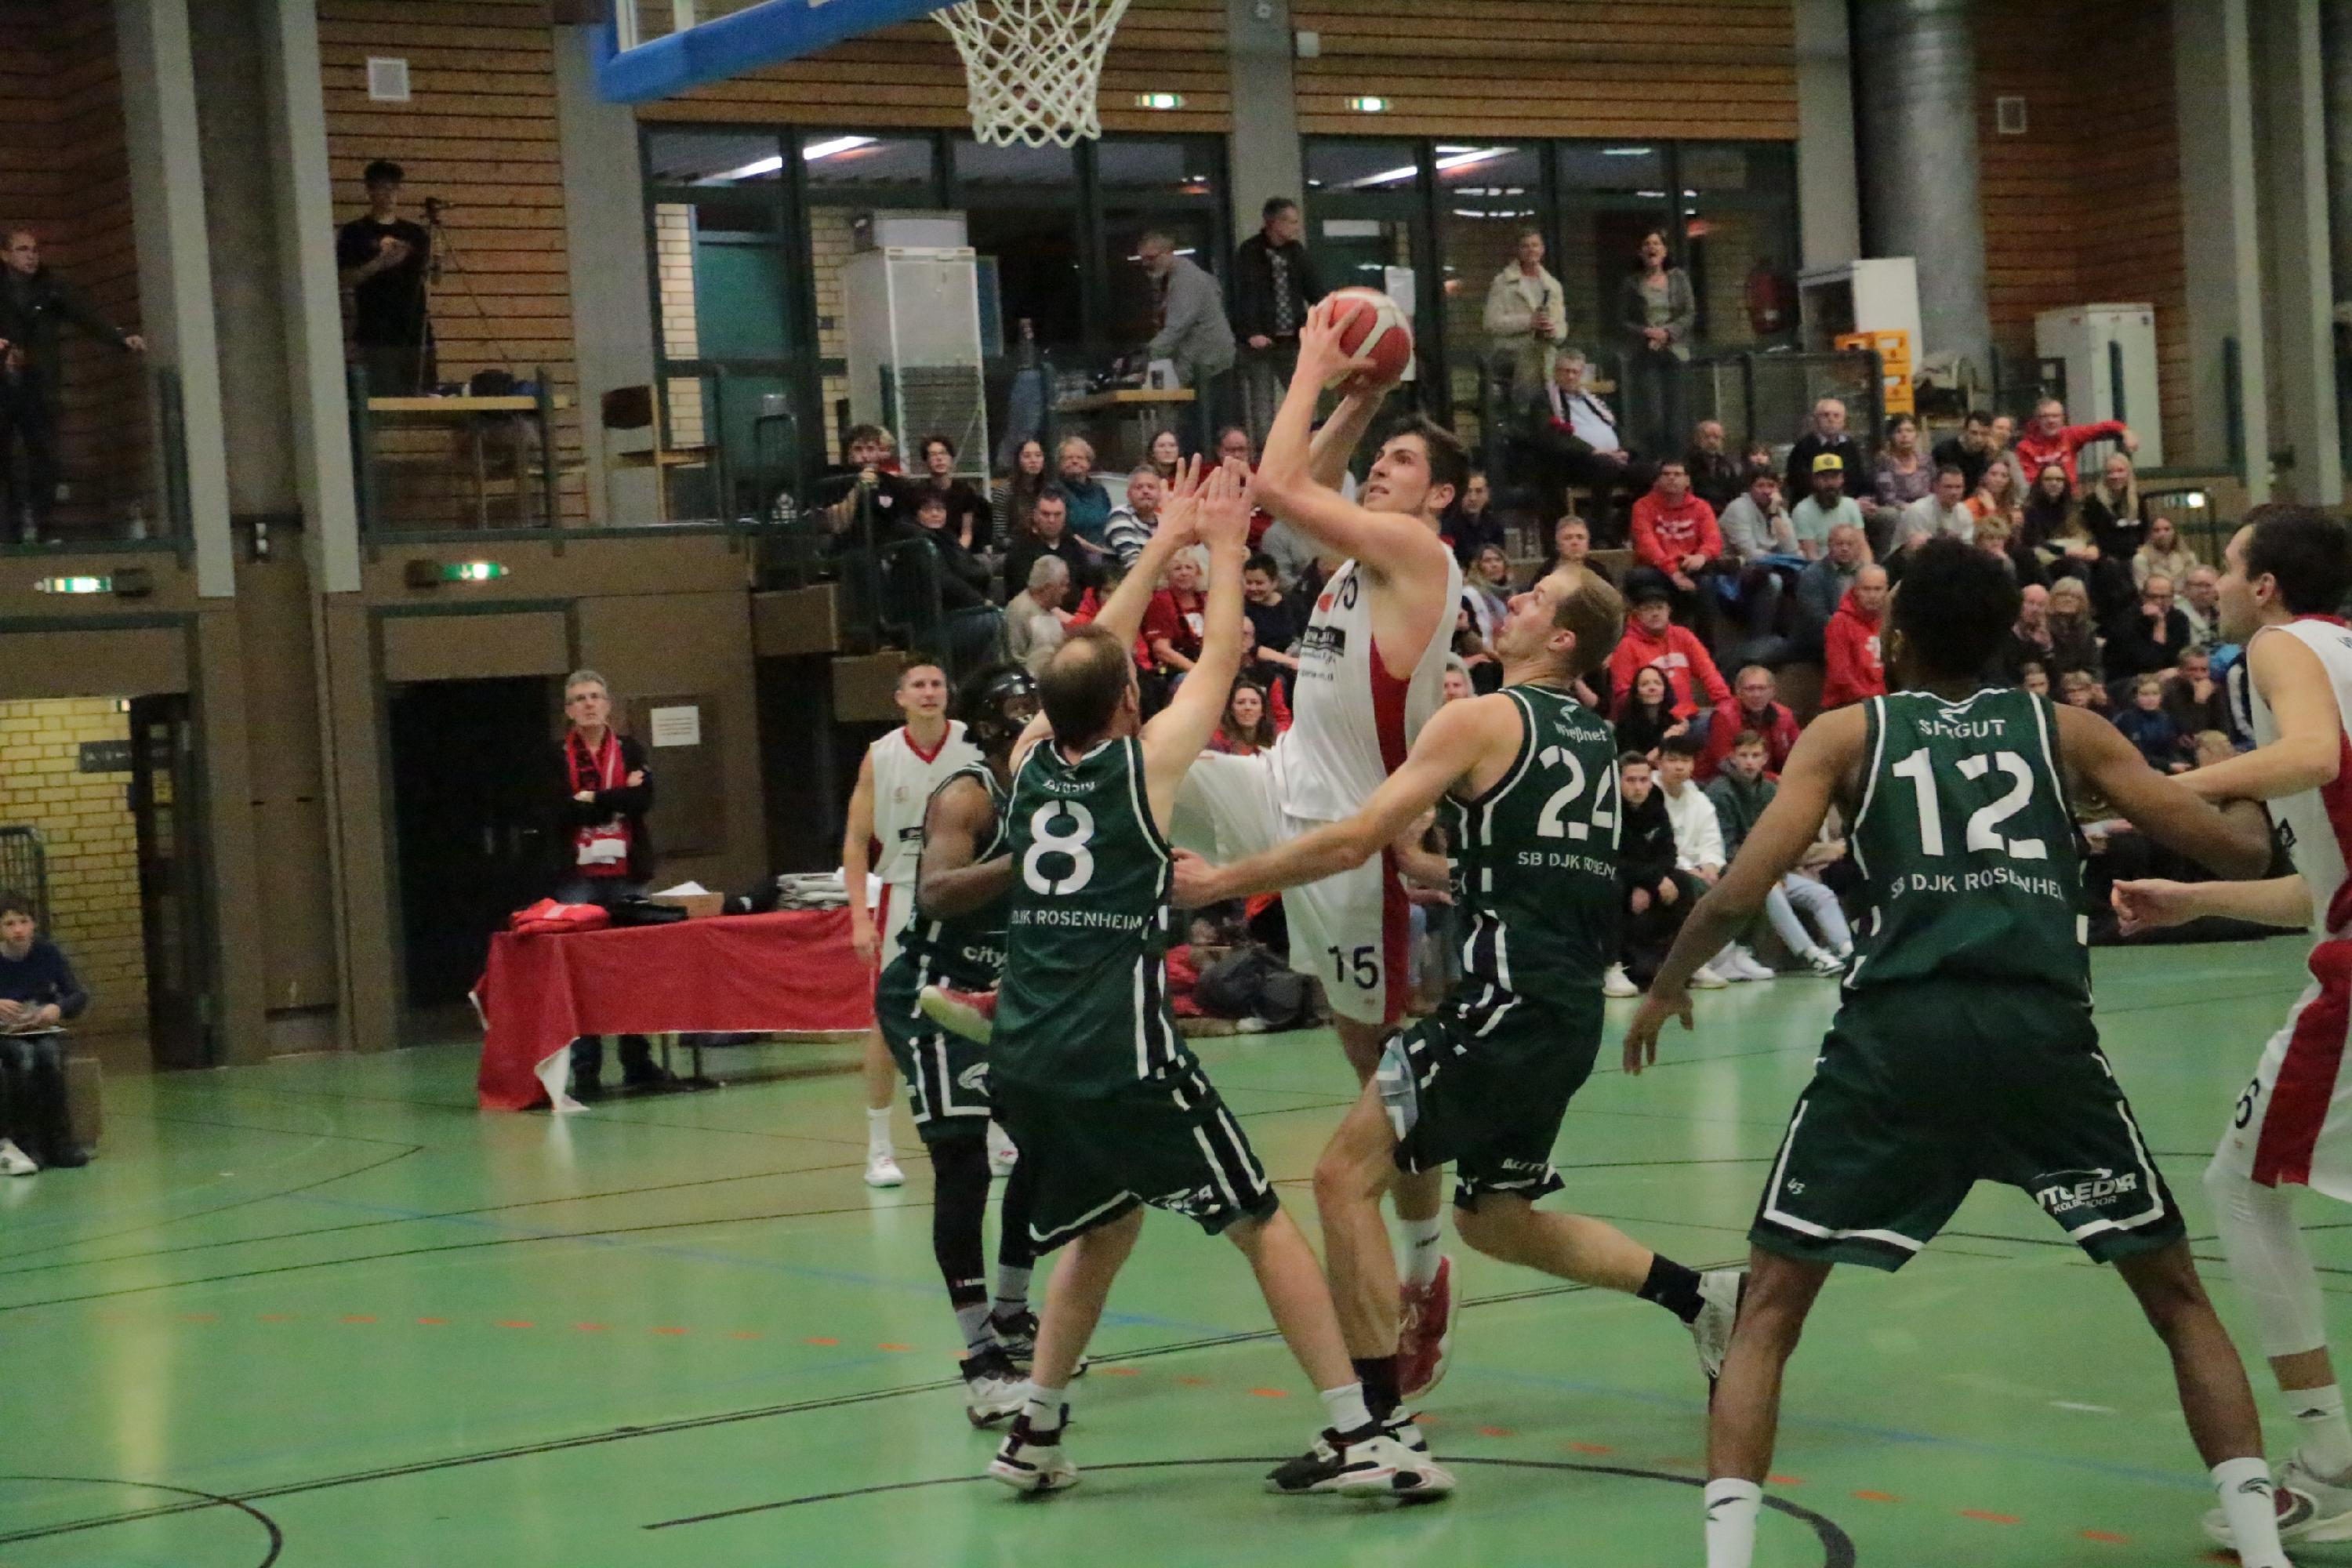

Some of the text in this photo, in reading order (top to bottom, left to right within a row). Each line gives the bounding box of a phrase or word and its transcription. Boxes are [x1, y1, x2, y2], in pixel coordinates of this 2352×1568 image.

[1537, 745, 1623, 851] 24
[1892, 746, 2048, 860] 12
[1022, 800, 1095, 895] 8
[1518, 851, 1542, 866] SB
[1549, 853, 1580, 870] DJK
[1911, 873, 1958, 892] DJK
[1036, 909, 1142, 931] ROSENHEIM
[1327, 946, 1379, 989] 15
